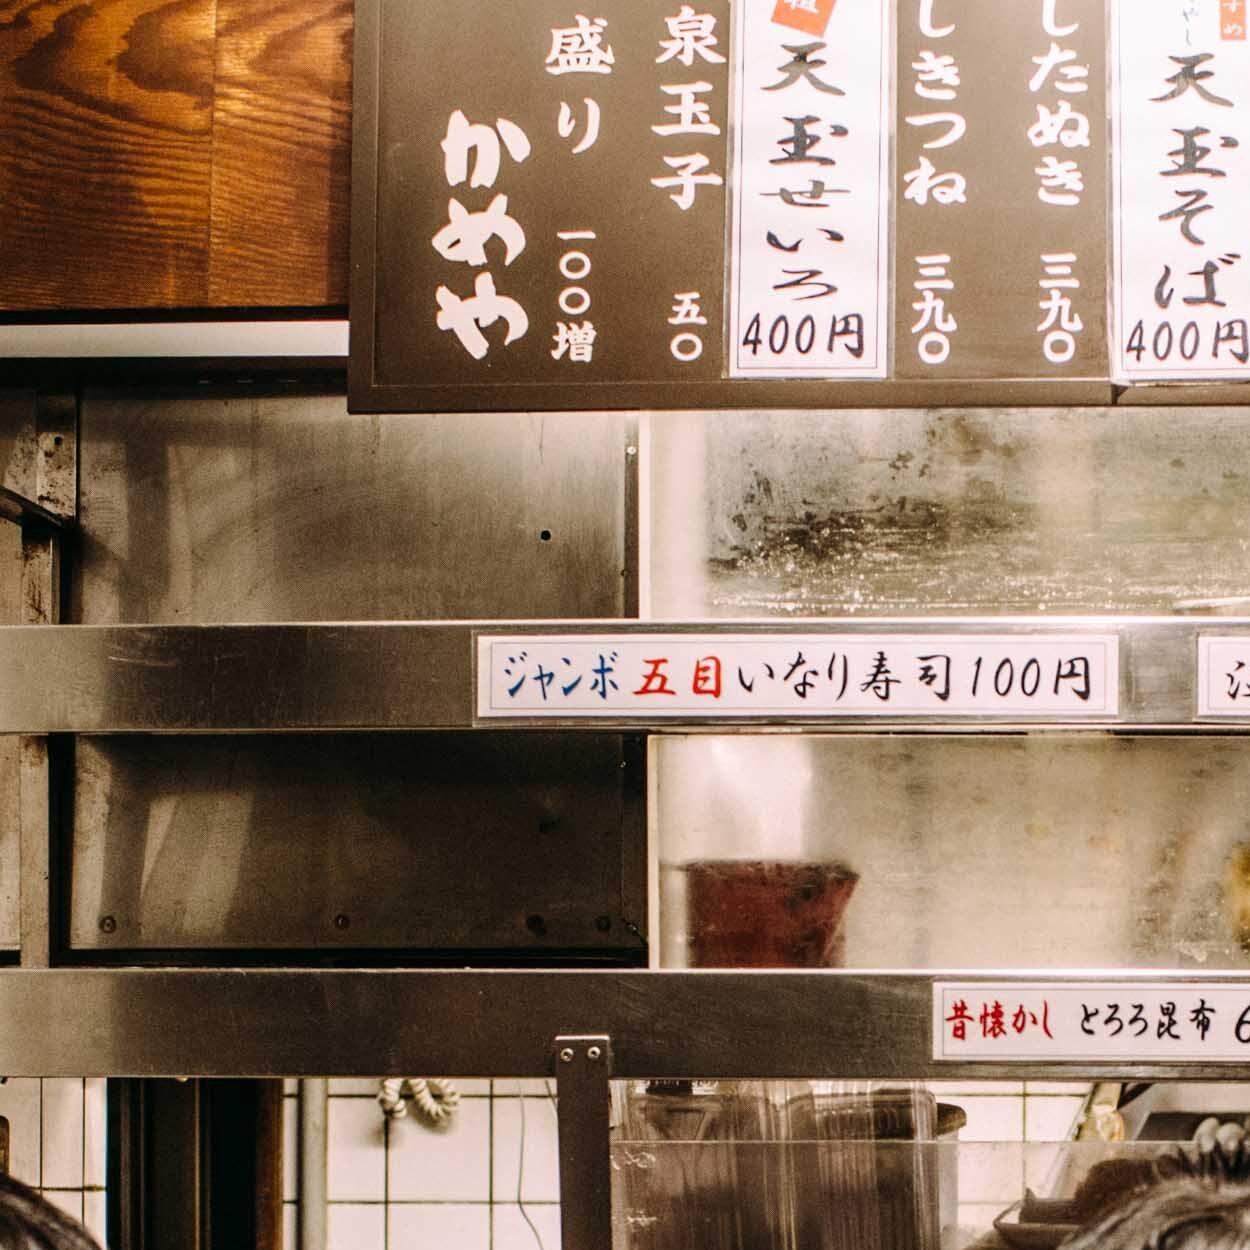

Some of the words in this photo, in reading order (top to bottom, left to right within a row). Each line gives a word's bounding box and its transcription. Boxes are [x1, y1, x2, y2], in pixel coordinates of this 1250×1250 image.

[545, 14, 616, 154] 盛り
[650, 5, 729, 211] 泉玉子
[903, 0, 967, 206] しきつね
[1027, 0, 1090, 206] したぬき
[431, 109, 532, 360] かめや
[759, 41, 850, 301] 天玉せいろ
[1150, 52, 1242, 310] 天玉そば
[667, 291, 708, 362] 五〇
[742, 312, 865, 359] 400円
[911, 254, 958, 365] 三九〇
[1036, 252, 1084, 364] 三九〇
[1125, 319, 1250, 365] 400円
[944, 999, 1053, 1041] 昔懐かし
